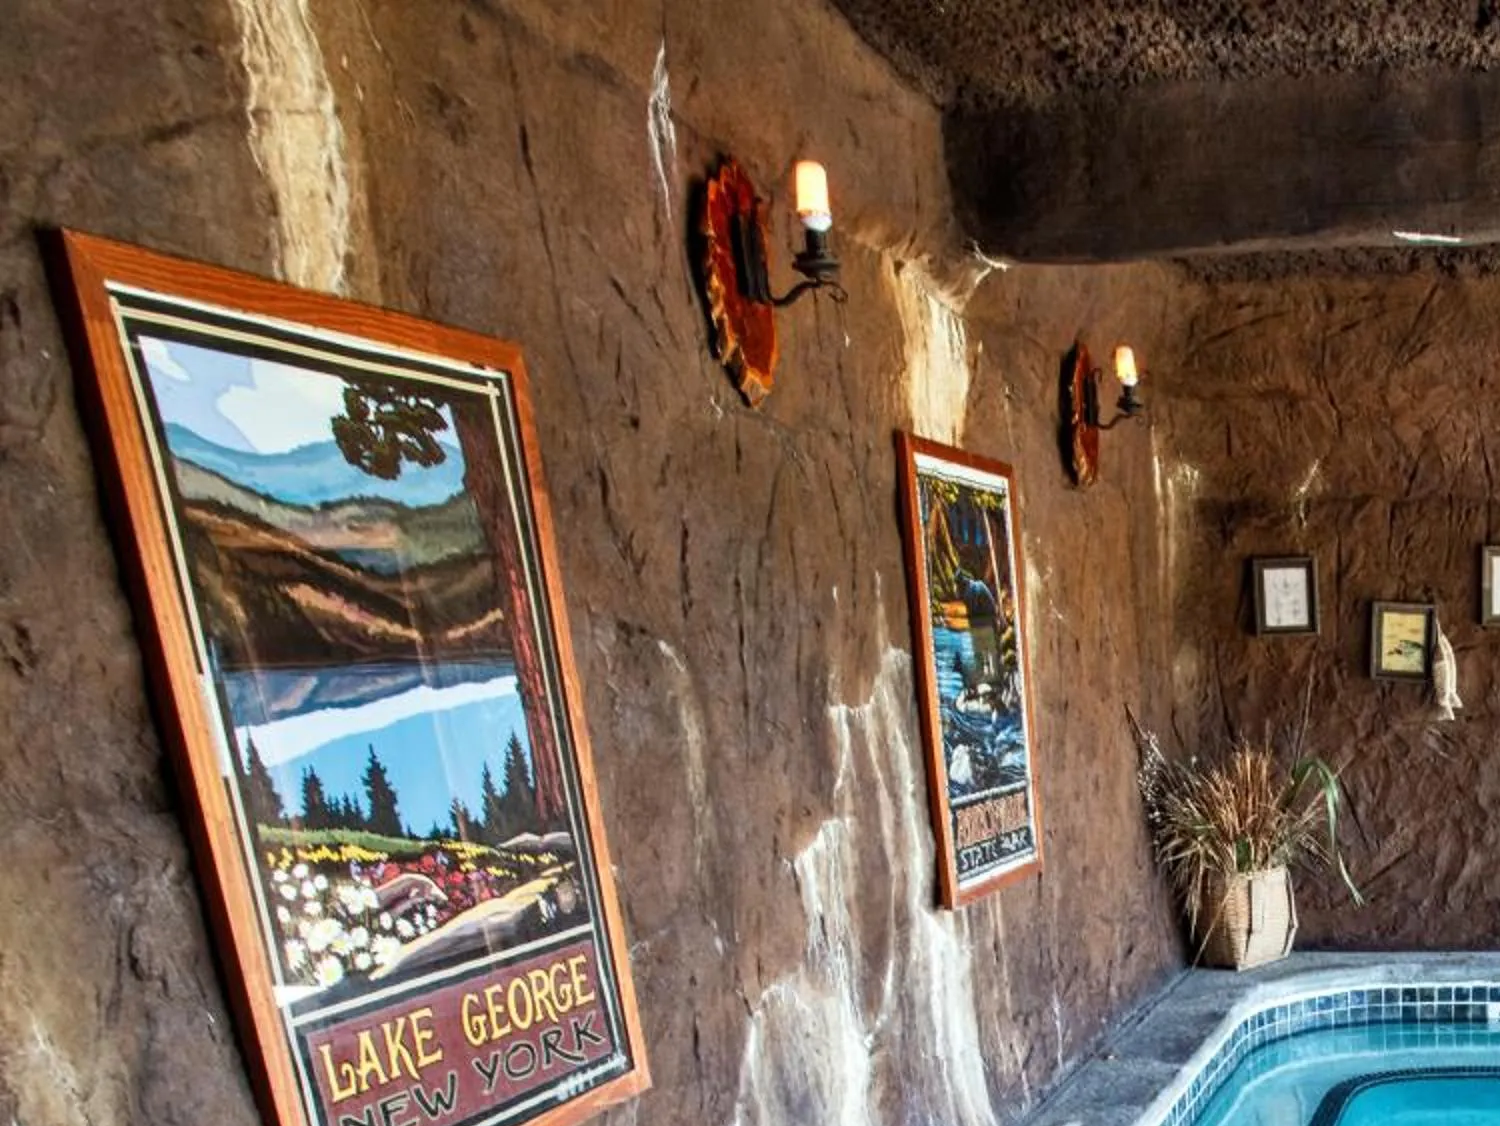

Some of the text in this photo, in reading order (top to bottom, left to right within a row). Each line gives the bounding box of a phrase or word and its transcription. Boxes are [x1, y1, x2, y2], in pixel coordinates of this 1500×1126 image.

[319, 954, 596, 1103] LAKE GEORGE
[472, 1009, 606, 1094] YORK
